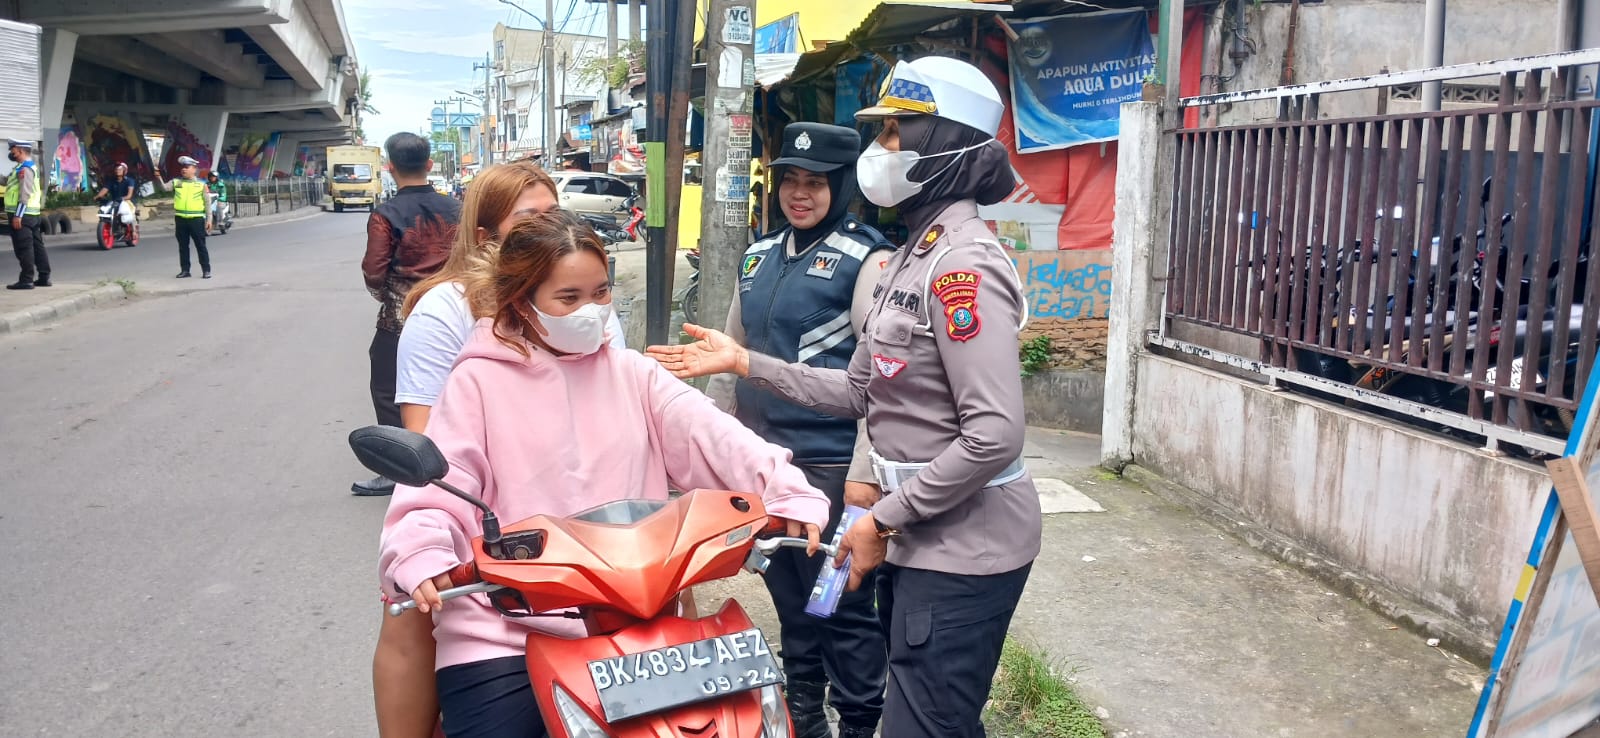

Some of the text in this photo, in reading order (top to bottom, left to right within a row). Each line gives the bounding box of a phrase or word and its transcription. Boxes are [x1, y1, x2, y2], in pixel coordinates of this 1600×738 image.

[1037, 53, 1156, 80] APAPUN AKTIVITAS
[1063, 75, 1105, 95] AQUA
[1101, 92, 1142, 105] TERLINDUN
[935, 273, 975, 291] POLDA
[714, 629, 769, 664] AEZ
